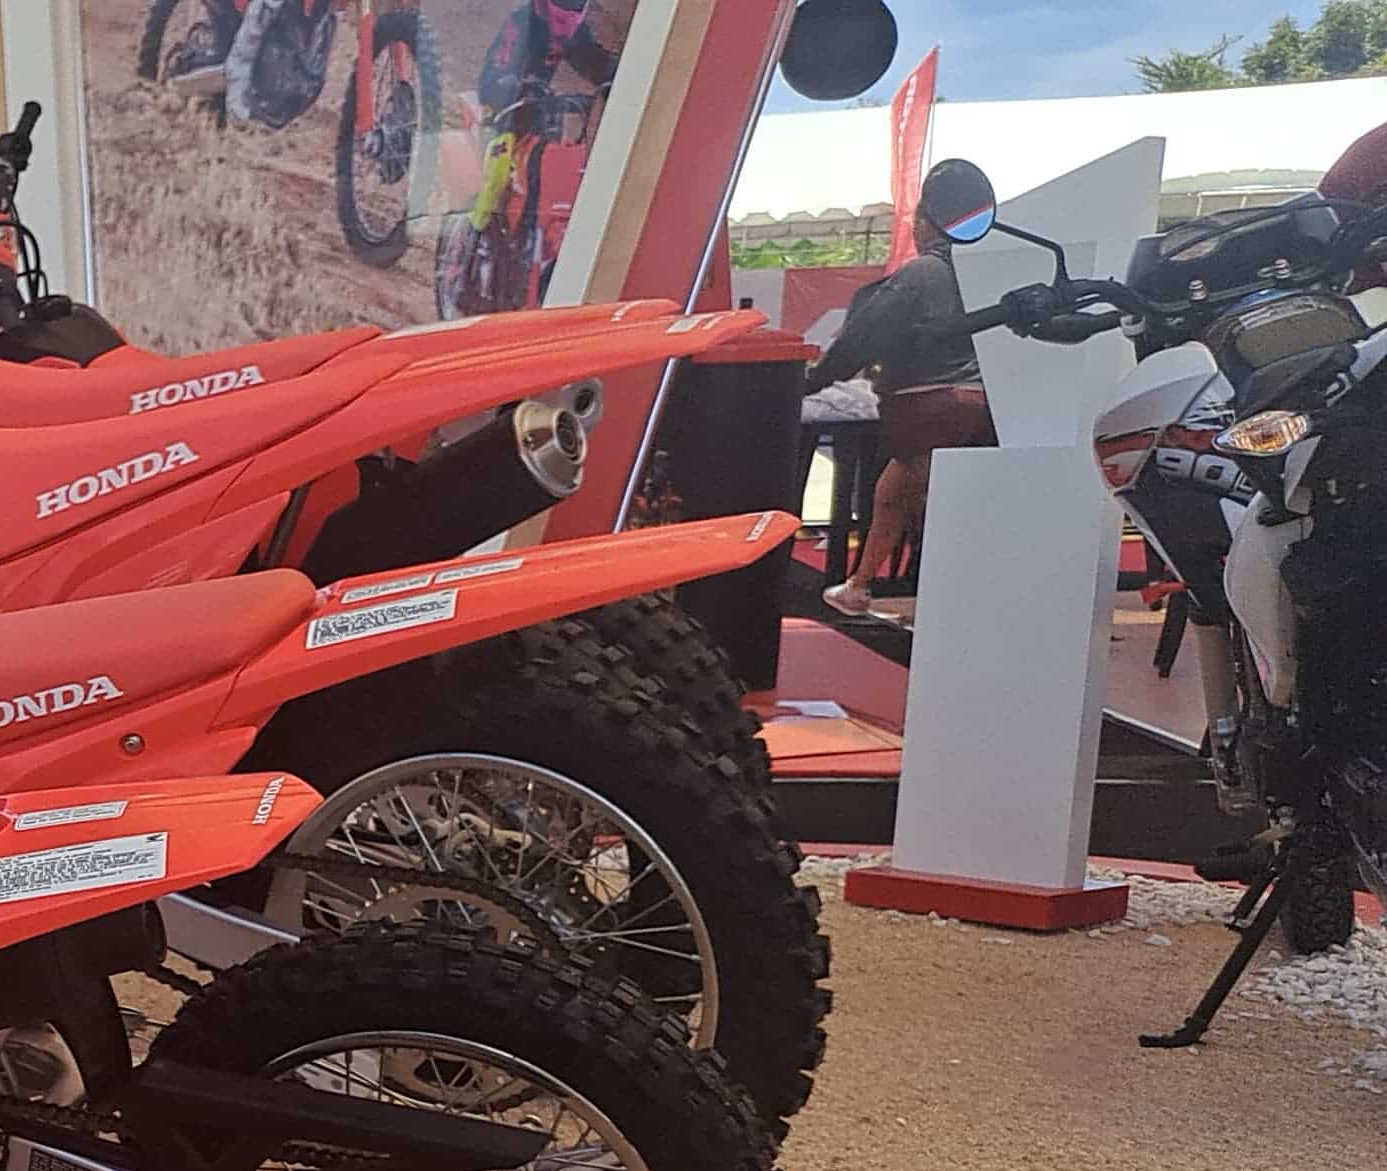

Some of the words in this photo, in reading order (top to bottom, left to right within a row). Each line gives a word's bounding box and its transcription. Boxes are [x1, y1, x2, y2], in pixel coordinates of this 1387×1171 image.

[129, 364, 265, 415] HONDA
[35, 442, 200, 520] HONDA
[252, 776, 285, 826] HONDA
